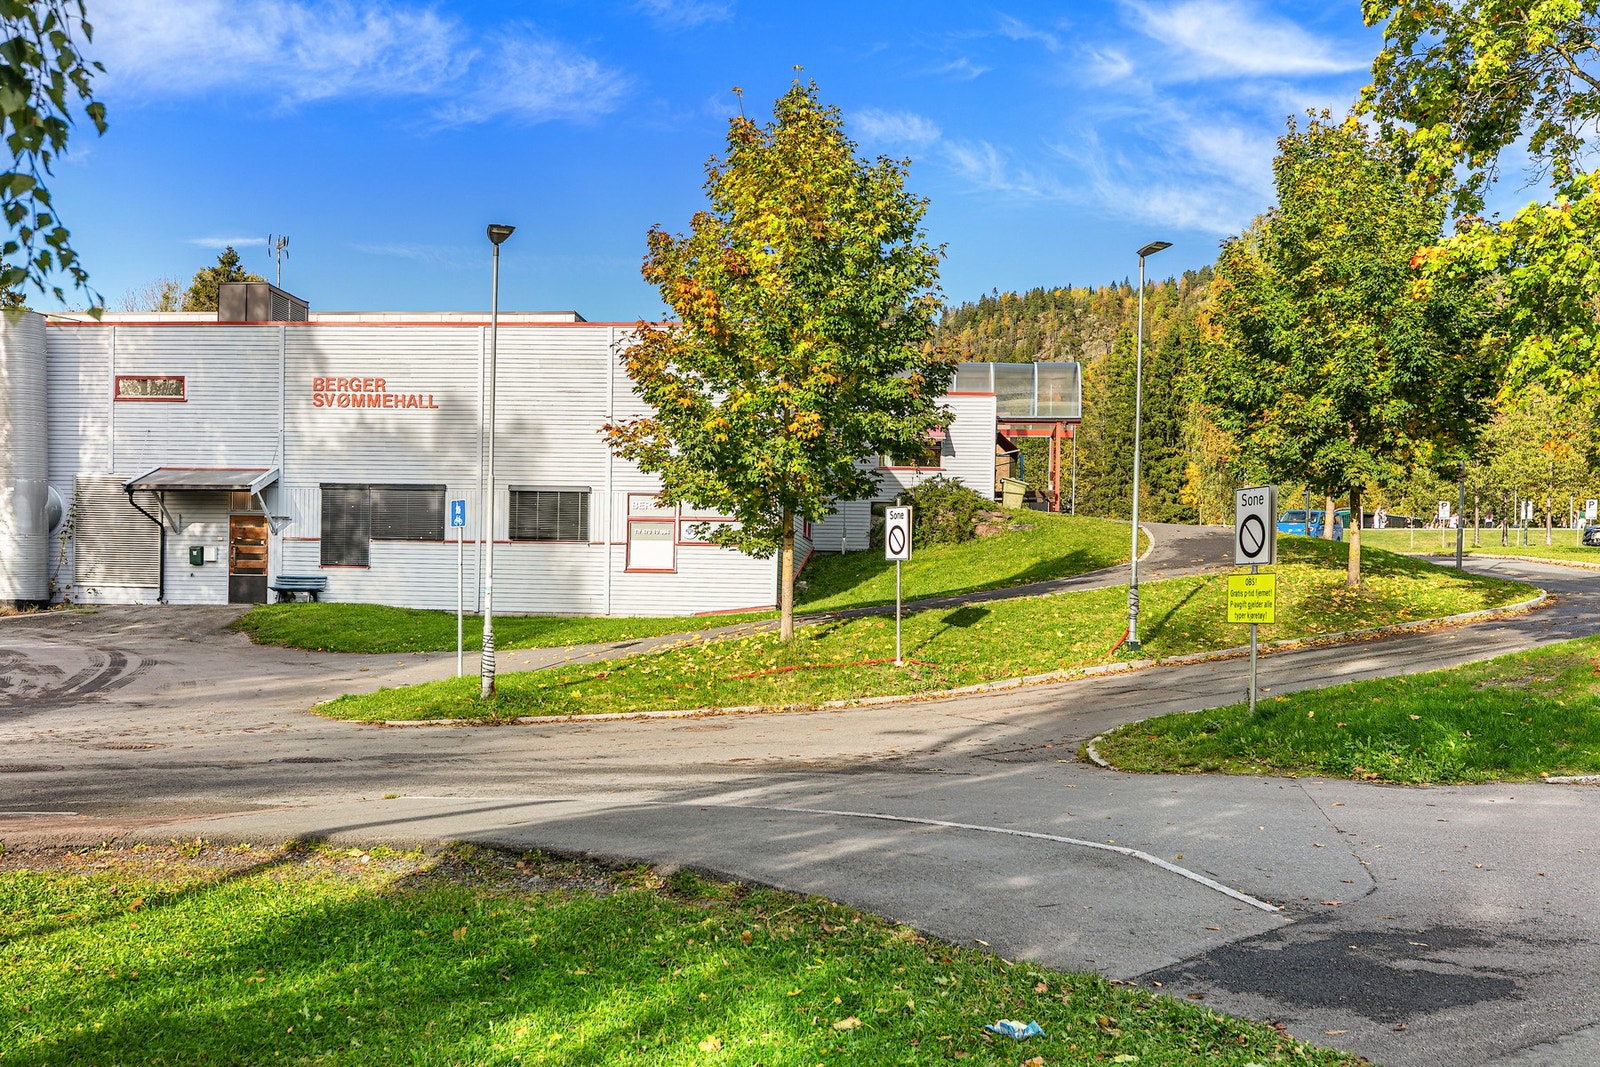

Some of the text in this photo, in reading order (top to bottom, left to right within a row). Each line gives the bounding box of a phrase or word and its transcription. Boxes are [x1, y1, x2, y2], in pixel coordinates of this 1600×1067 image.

[312, 377, 386, 392] BERGER
[312, 393, 439, 409] SVØMMEHALL
[1241, 493, 1264, 507] Sone
[1588, 501, 1595, 509] P
[1441, 502, 1448, 510] P
[890, 510, 904, 520] Sone
[1244, 577, 1257, 586] OBS!
